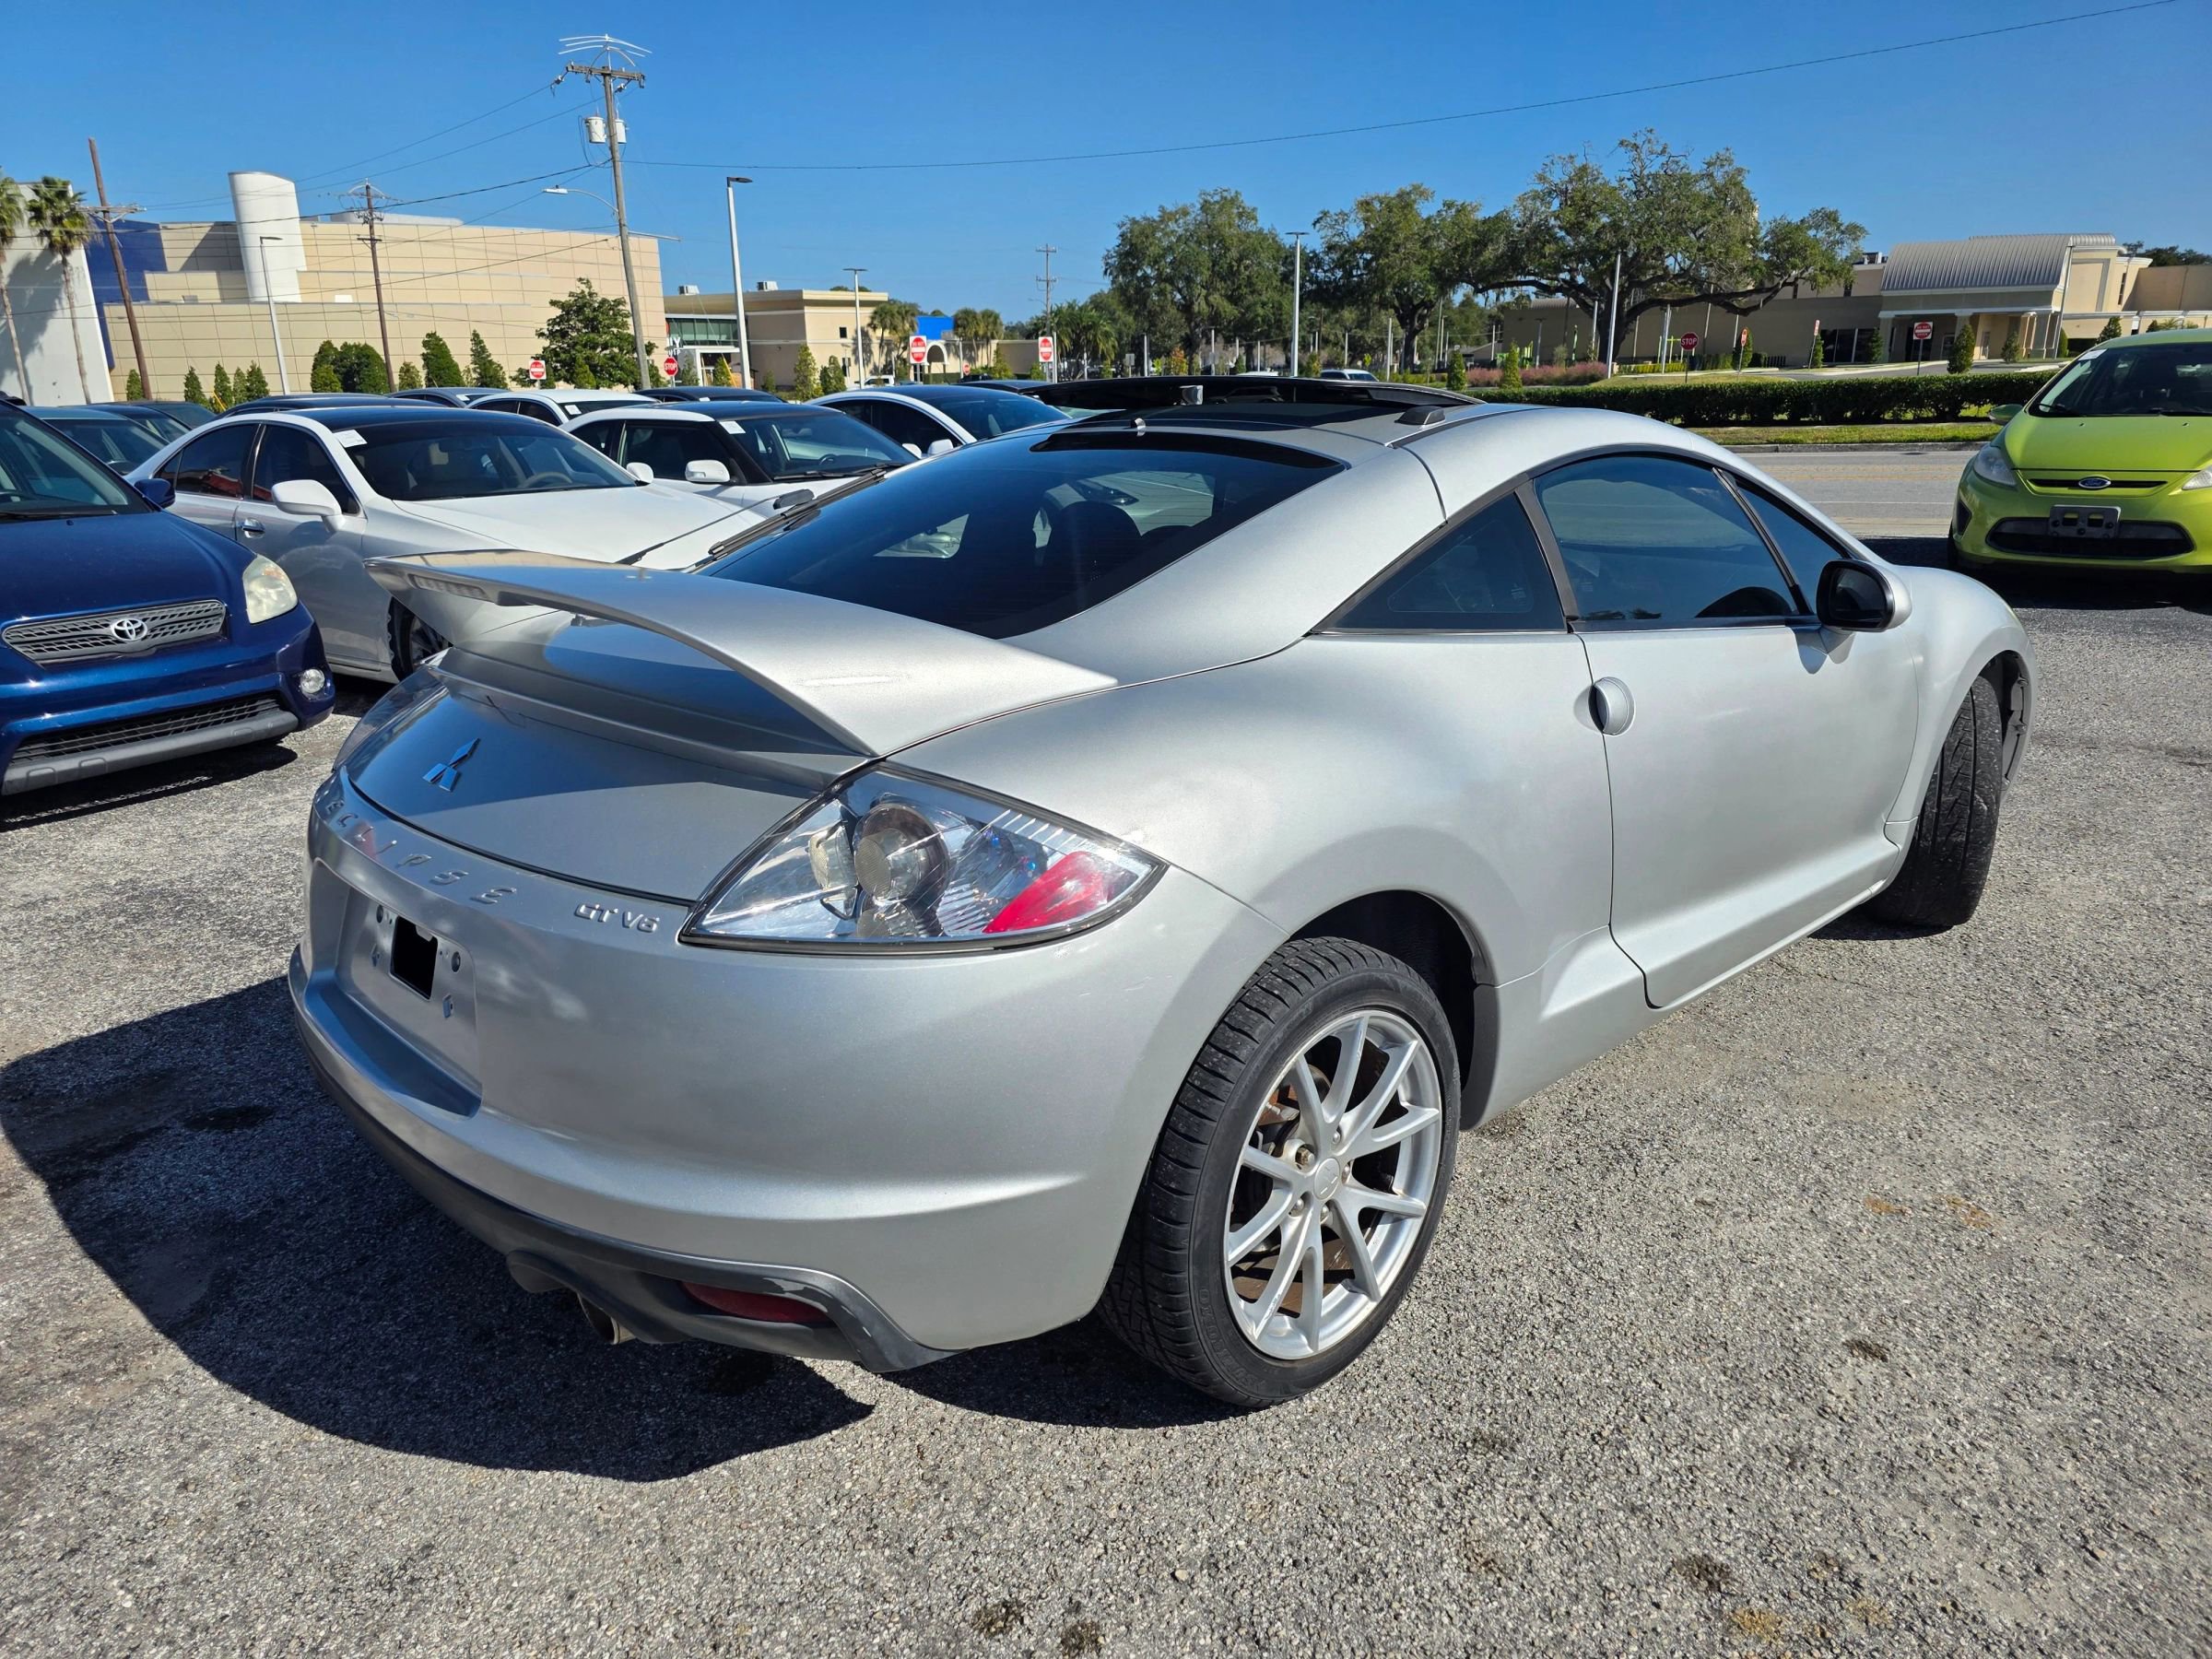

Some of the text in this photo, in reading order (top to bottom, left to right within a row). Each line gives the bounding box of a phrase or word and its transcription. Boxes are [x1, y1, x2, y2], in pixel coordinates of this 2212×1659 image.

[1681, 337, 1698, 346] STOP
[665, 362, 677, 371] STOP
[326, 799, 517, 904] ECLIPSE
